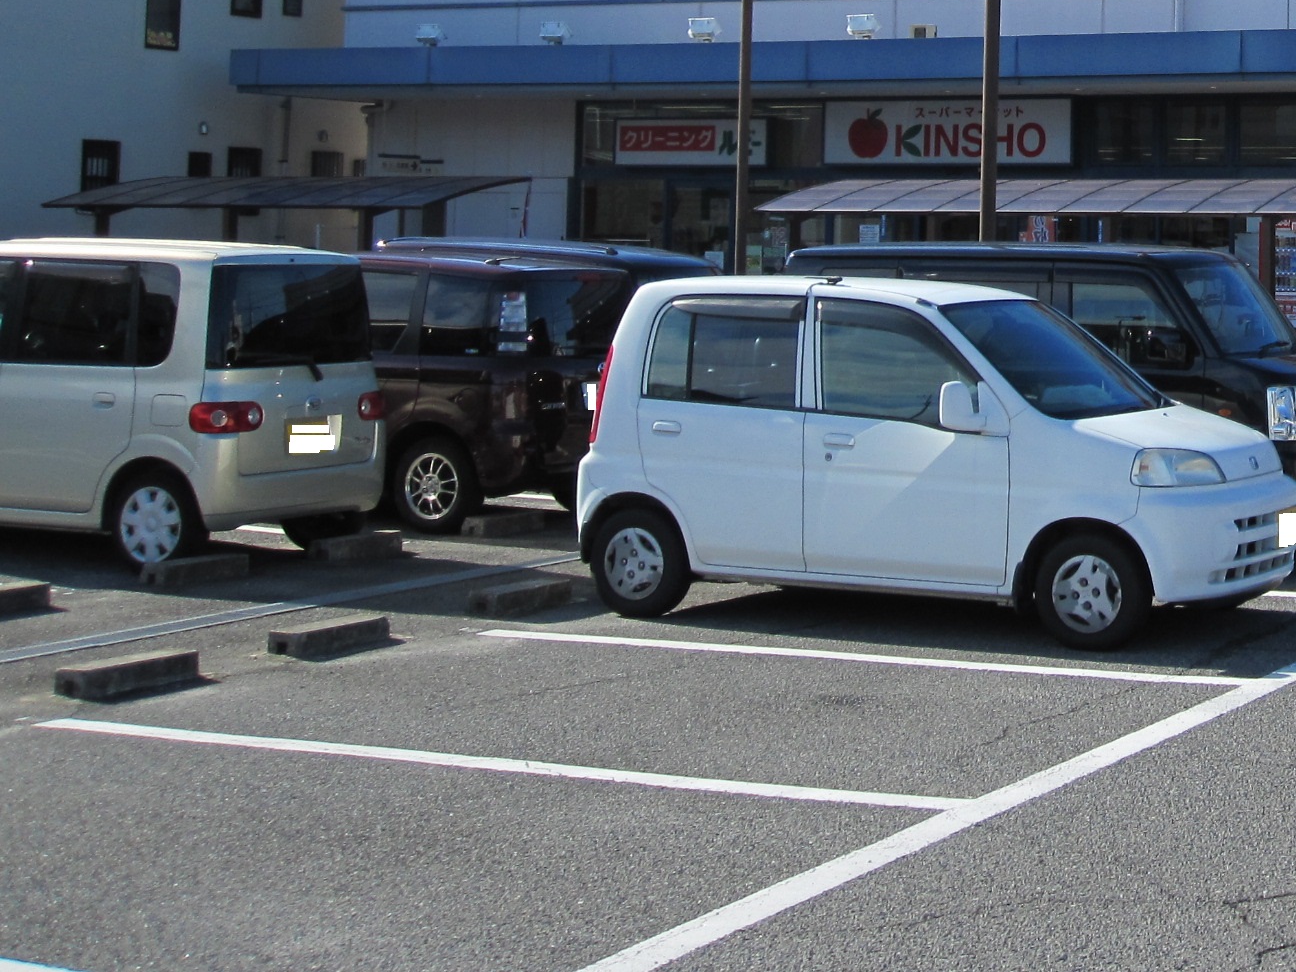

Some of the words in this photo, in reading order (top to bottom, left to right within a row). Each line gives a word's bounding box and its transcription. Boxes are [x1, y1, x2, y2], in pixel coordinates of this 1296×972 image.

[915, 106, 1024, 119] スーパーマーット
[624, 129, 713, 148] クリーニング
